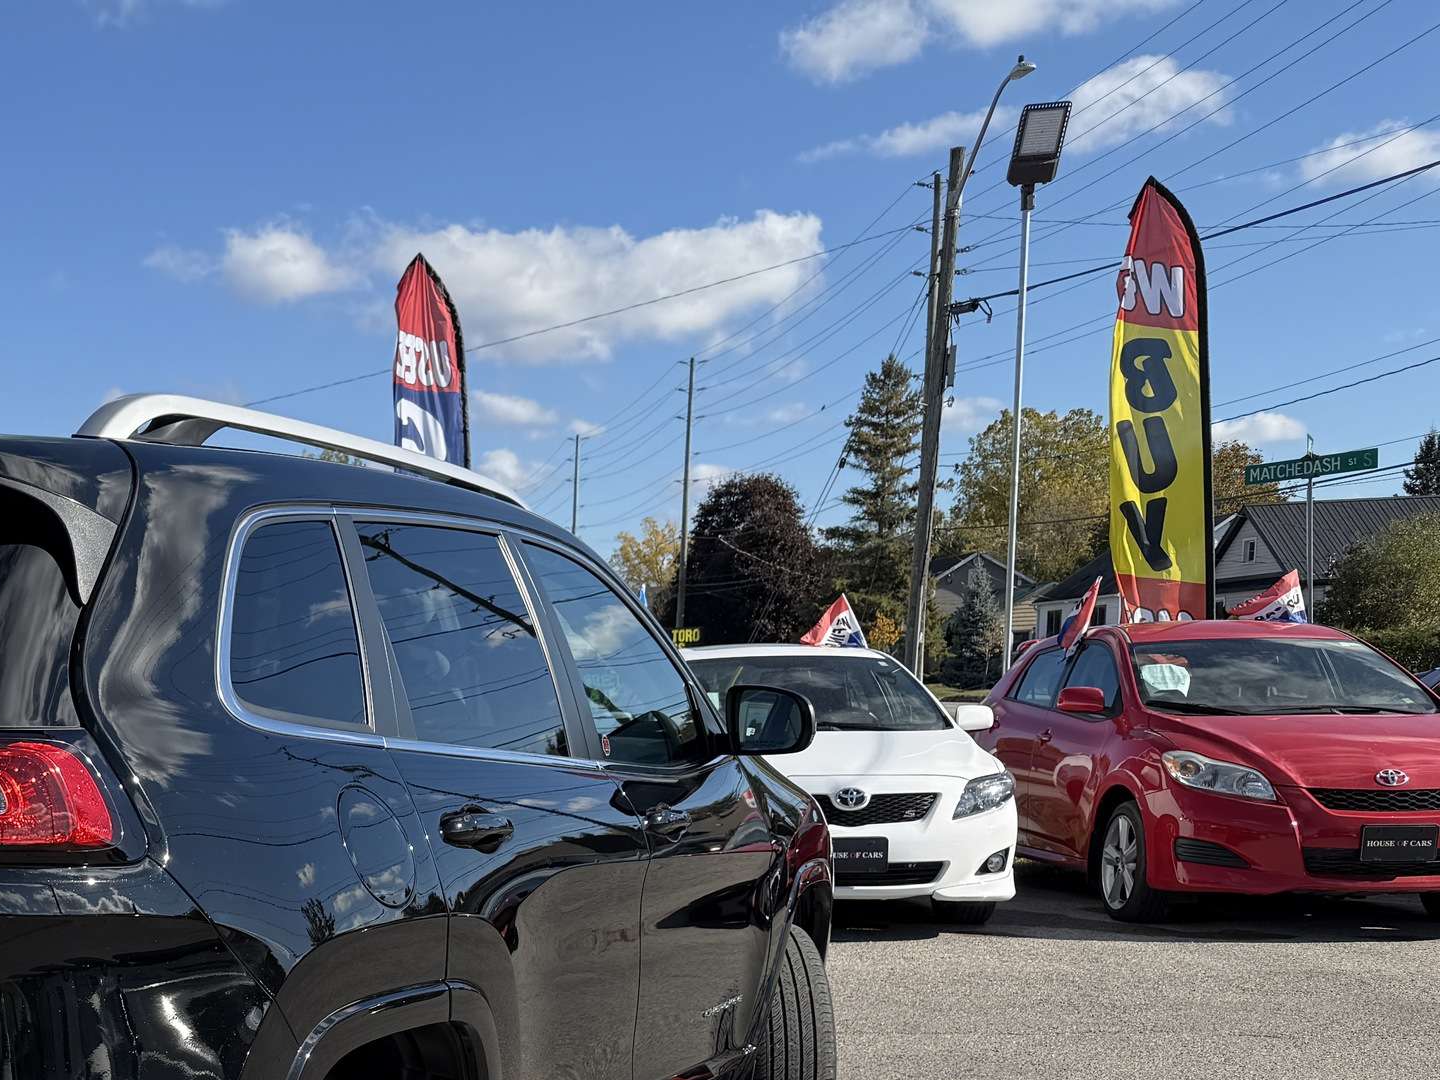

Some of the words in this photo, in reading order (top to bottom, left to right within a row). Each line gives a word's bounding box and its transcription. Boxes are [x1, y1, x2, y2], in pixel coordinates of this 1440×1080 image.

[1249, 456, 1341, 482] MATCHEDASH
[1363, 452, 1373, 467] S
[672, 628, 700, 643] TORO
[1366, 840, 1396, 848] HOUSE
[1409, 839, 1433, 848] CARS
[833, 851, 849, 859] USE
[862, 851, 884, 859] CARS
